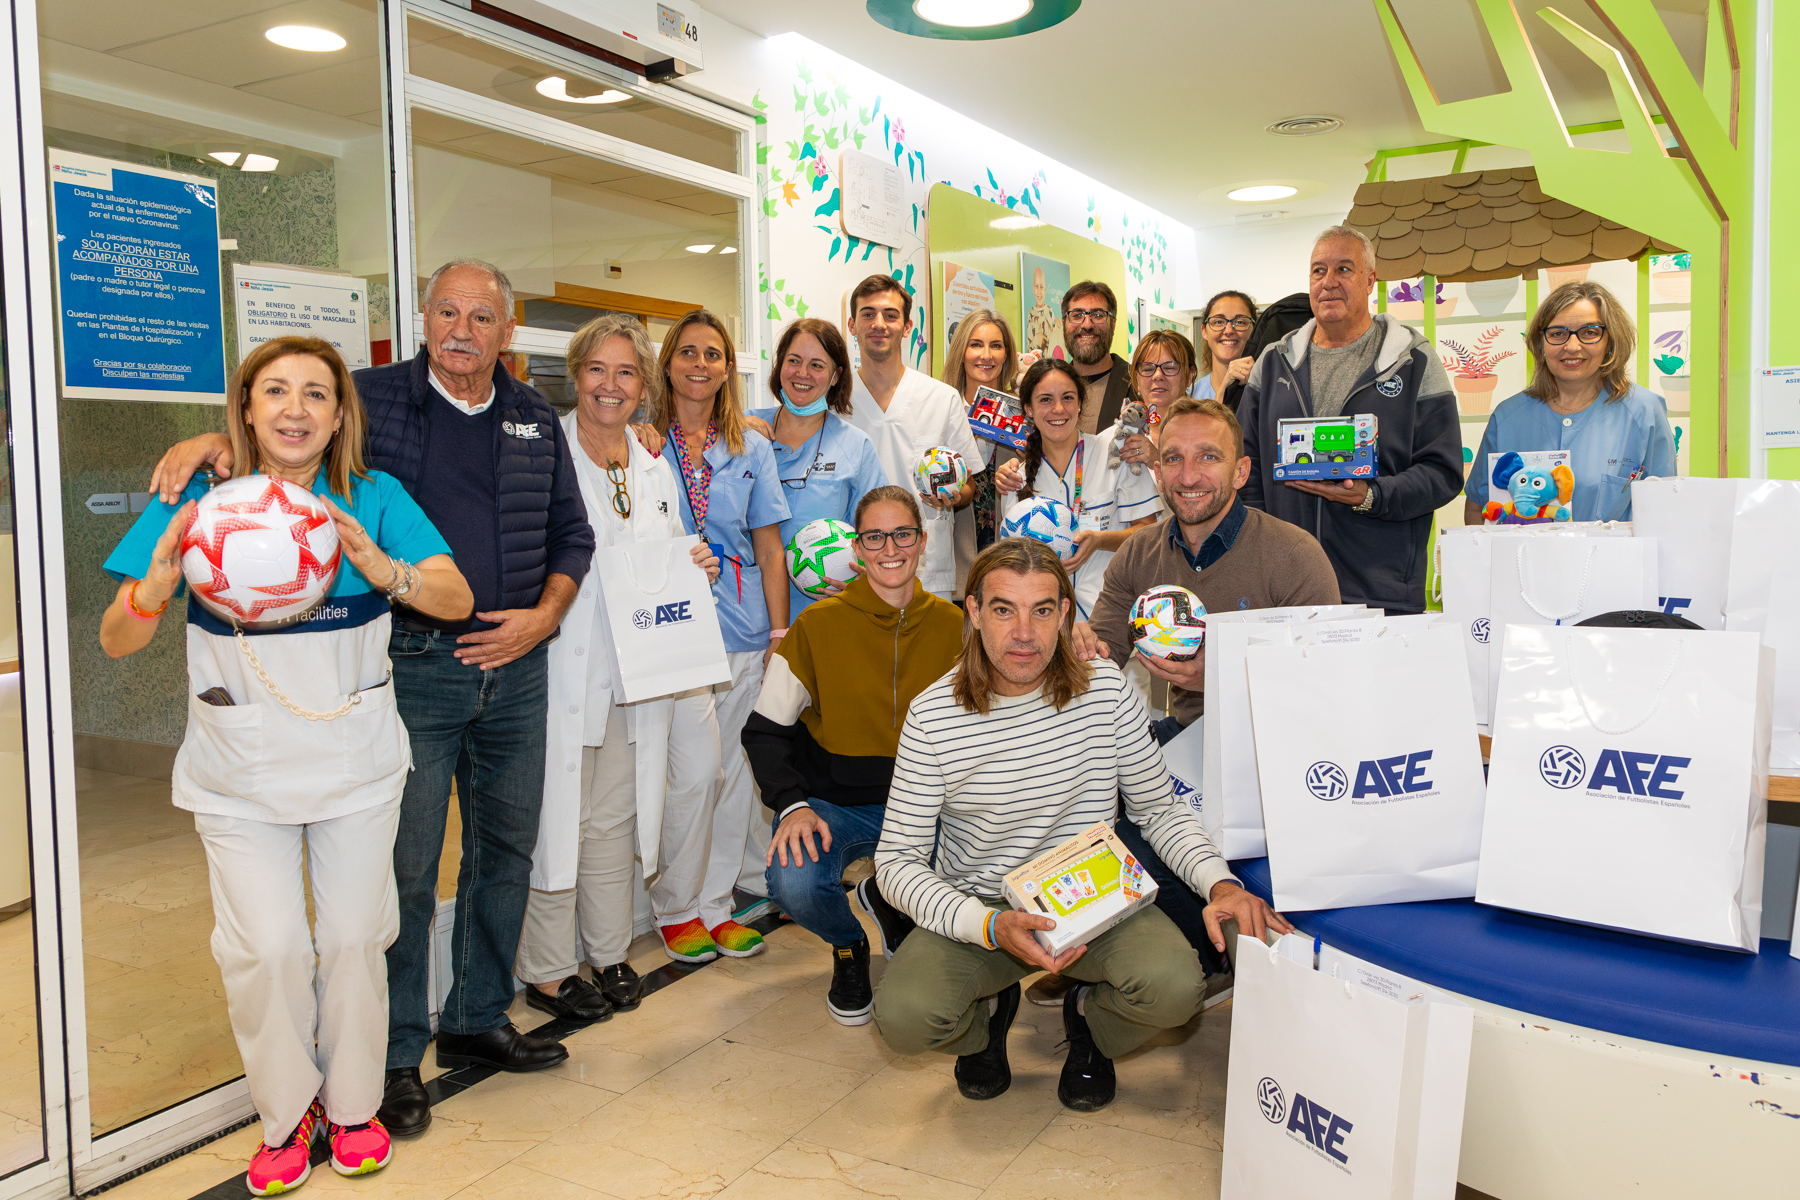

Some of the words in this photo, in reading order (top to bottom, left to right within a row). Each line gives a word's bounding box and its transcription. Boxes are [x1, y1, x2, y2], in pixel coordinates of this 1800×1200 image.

[685, 23, 697, 41] 48
[74, 188, 94, 198] Dada
[106, 194, 138, 205] situación
[140, 199, 191, 214] epidemiológica
[91, 202, 114, 210] actual
[135, 207, 177, 220] enfermedad
[89, 211, 101, 219] por
[112, 215, 134, 223] nuevo
[136, 217, 180, 230] Coronavirus:
[91, 230, 104, 238] Los
[107, 233, 142, 245] pacientes
[143, 238, 181, 250] ingresados
[82, 239, 111, 250] SOLO
[114, 243, 156, 257] PODRÁN
[159, 247, 190, 261] ESTAR
[73, 249, 153, 268] ACOMPAÑADOS
[156, 261, 177, 271] POR
[179, 264, 199, 273] UNA
[114, 267, 163, 280] PERSONA
[70, 272, 95, 282] (padre
[104, 276, 127, 285] madre
[153, 282, 170, 290] legal
[178, 286, 205, 294] persona
[102, 286, 139, 296] designada
[155, 291, 176, 300] ellos).
[67, 310, 97, 319] Quedan
[99, 313, 137, 322] prohibidas
[102, 322, 129, 332] Plantas
[142, 326, 194, 337] Hospitalización
[119, 333, 144, 342] Bloque
[146, 335, 184, 345] Quirúrgico.
[94, 359, 122, 367] Gracias
[148, 362, 192, 372] colaboración
[102, 369, 138, 378] Disculpen
[152, 372, 185, 380] molestias
[515, 423, 539, 437] AFE
[655, 600, 692, 625] AFE
[1352, 750, 1433, 798] AFE
[1587, 748, 1692, 800] AFE
[1388, 795, 1415, 803] Futbolistas
[1416, 790, 1440, 798] Españoles
[1585, 791, 1616, 800] Asociación
[1627, 796, 1659, 805] Futbolistas
[1661, 800, 1690, 809] Españoles
[1287, 1092, 1353, 1165] AFE
[1286, 1130, 1305, 1146] Asociación
[1311, 1146, 1331, 1163] Futbolistas
[1333, 1159, 1352, 1176] Españoles
